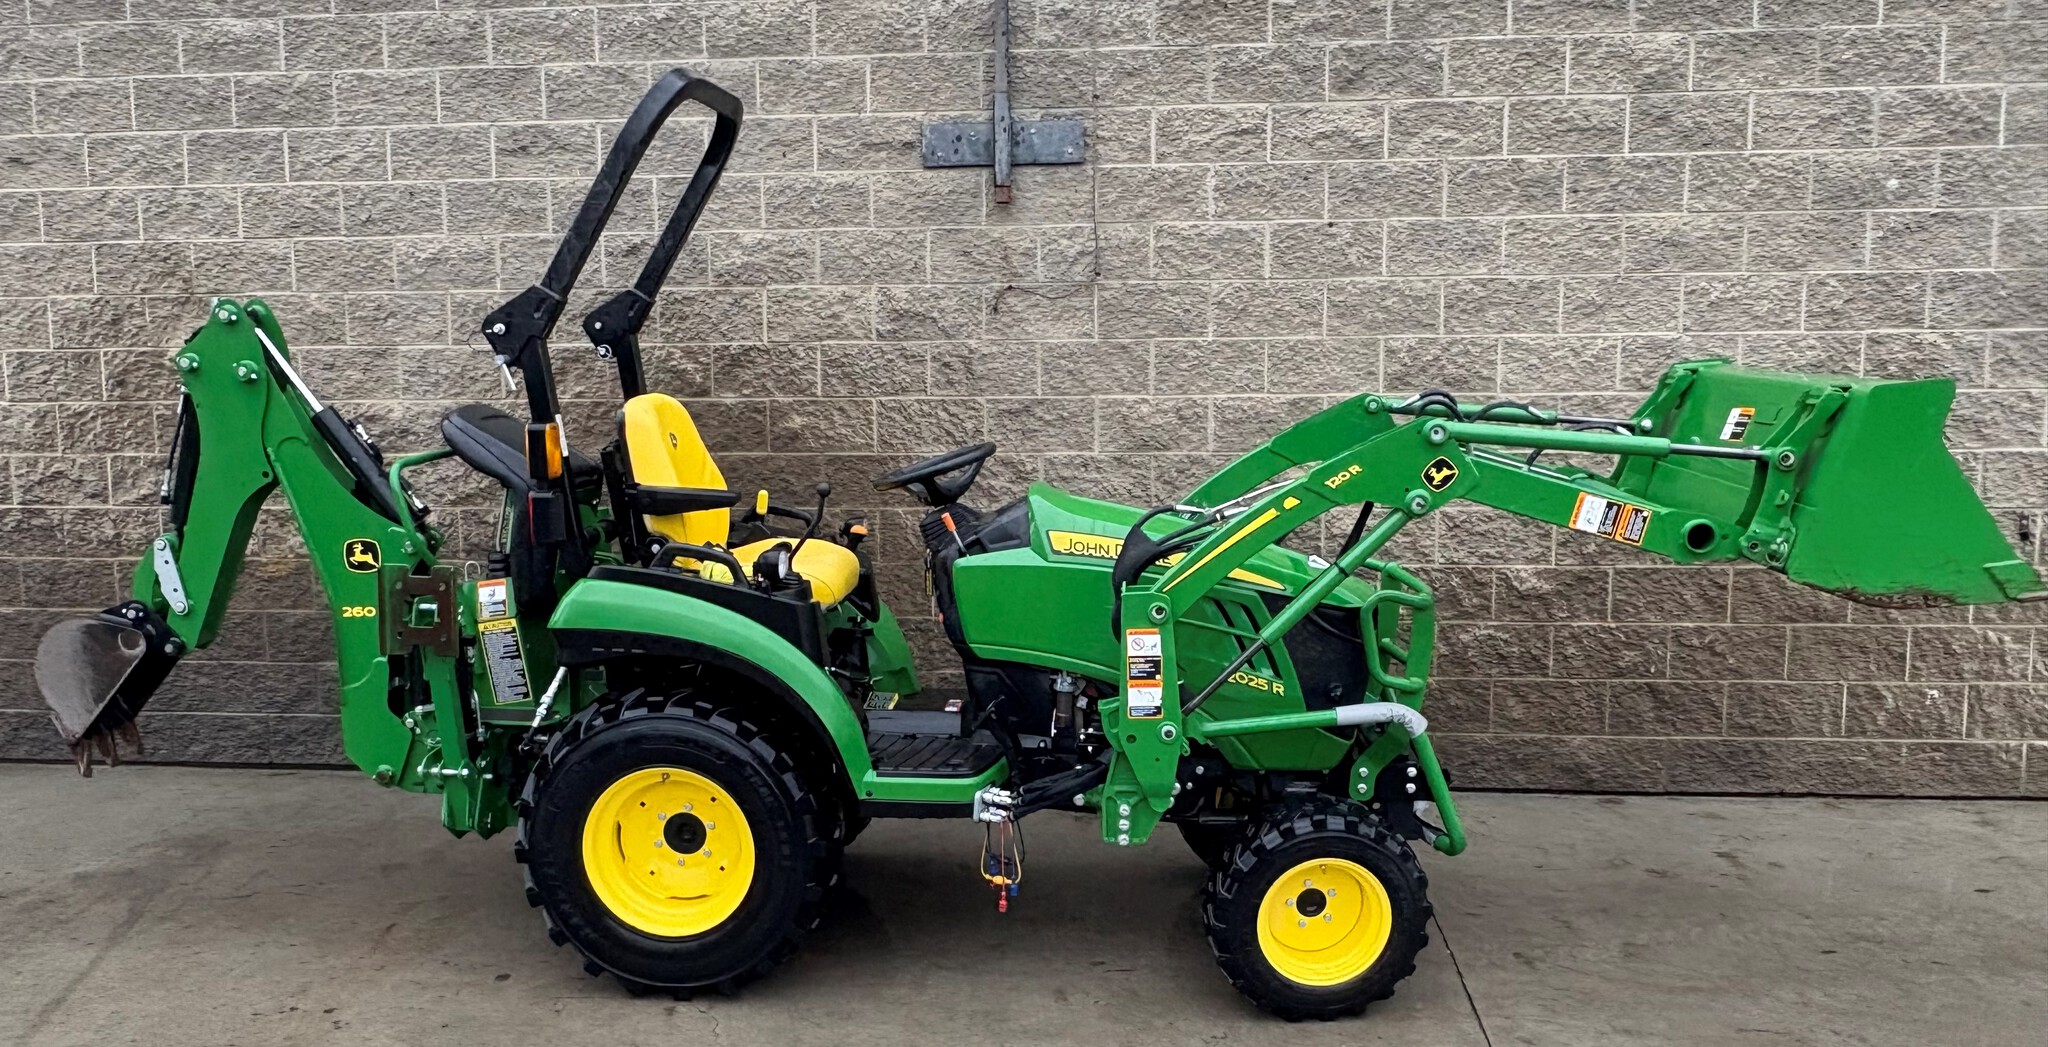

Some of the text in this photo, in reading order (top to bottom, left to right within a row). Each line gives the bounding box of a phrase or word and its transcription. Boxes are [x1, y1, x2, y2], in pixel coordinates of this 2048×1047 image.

[1063, 538, 1110, 556] JOHN
[341, 606, 377, 618] 260
[1272, 681, 1285, 697] R
